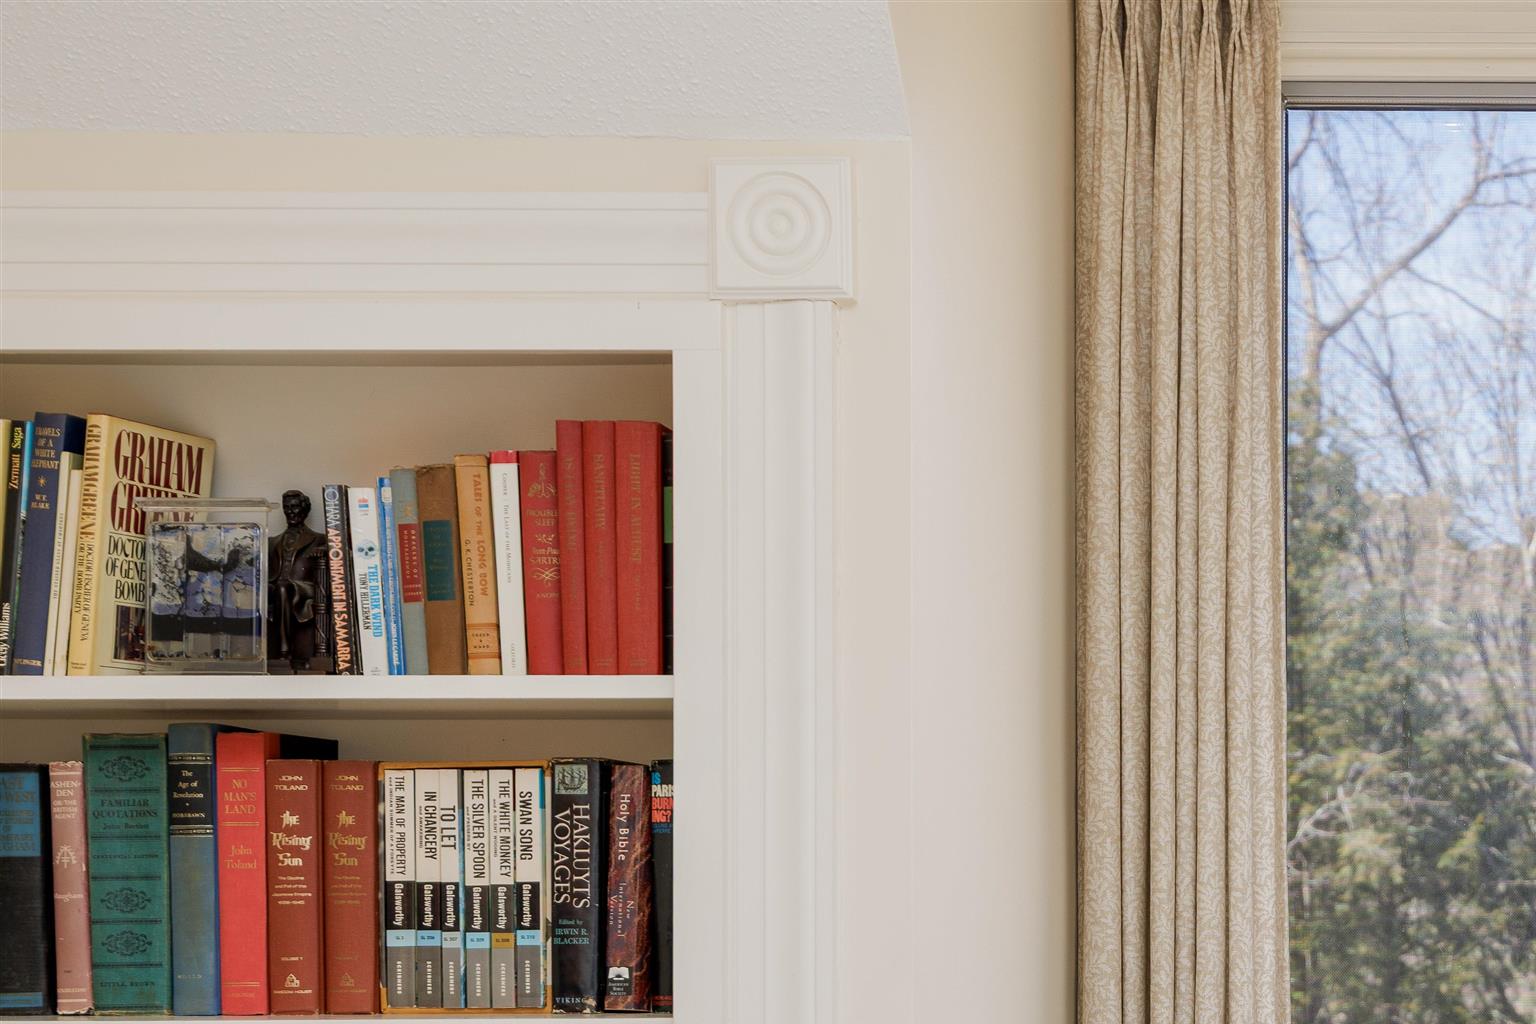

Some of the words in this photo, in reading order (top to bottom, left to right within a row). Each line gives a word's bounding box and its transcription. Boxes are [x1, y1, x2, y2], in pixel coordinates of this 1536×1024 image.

[84, 425, 101, 482] GRAHAM
[114, 429, 205, 498] GRAHAM
[473, 473, 482, 502] TALES
[79, 483, 99, 540] GREENE
[475, 506, 482, 516] OF
[476, 521, 484, 535] THE
[328, 529, 345, 602] APPOINTMENT
[477, 540, 487, 569] LONG
[369, 564, 379, 583] THE
[480, 573, 489, 596] BOW
[334, 603, 345, 611] IN
[370, 585, 381, 609] DARK
[371, 612, 383, 637] WIND
[334, 614, 350, 669] SAMARRA
[224, 791, 257, 802] MAN'S
[232, 779, 248, 789] NO
[424, 791, 436, 800] IN
[93, 809, 158, 818] QUOTATIONS
[225, 804, 255, 814] LAND
[441, 806, 456, 821] TO
[519, 791, 533, 821] SWAN
[614, 793, 631, 823] Holy
[271, 832, 313, 850] Rising
[424, 805, 437, 860] CHANCERY
[441, 824, 456, 850] LET
[520, 827, 533, 861] SONG
[618, 829, 630, 861] Bible
[277, 853, 303, 867] Sun
[553, 810, 570, 904] VOYAGES
[573, 803, 590, 909] HAKLUYT'S
[423, 883, 434, 927] Galsworthy
[522, 883, 532, 927] Galsworthy
